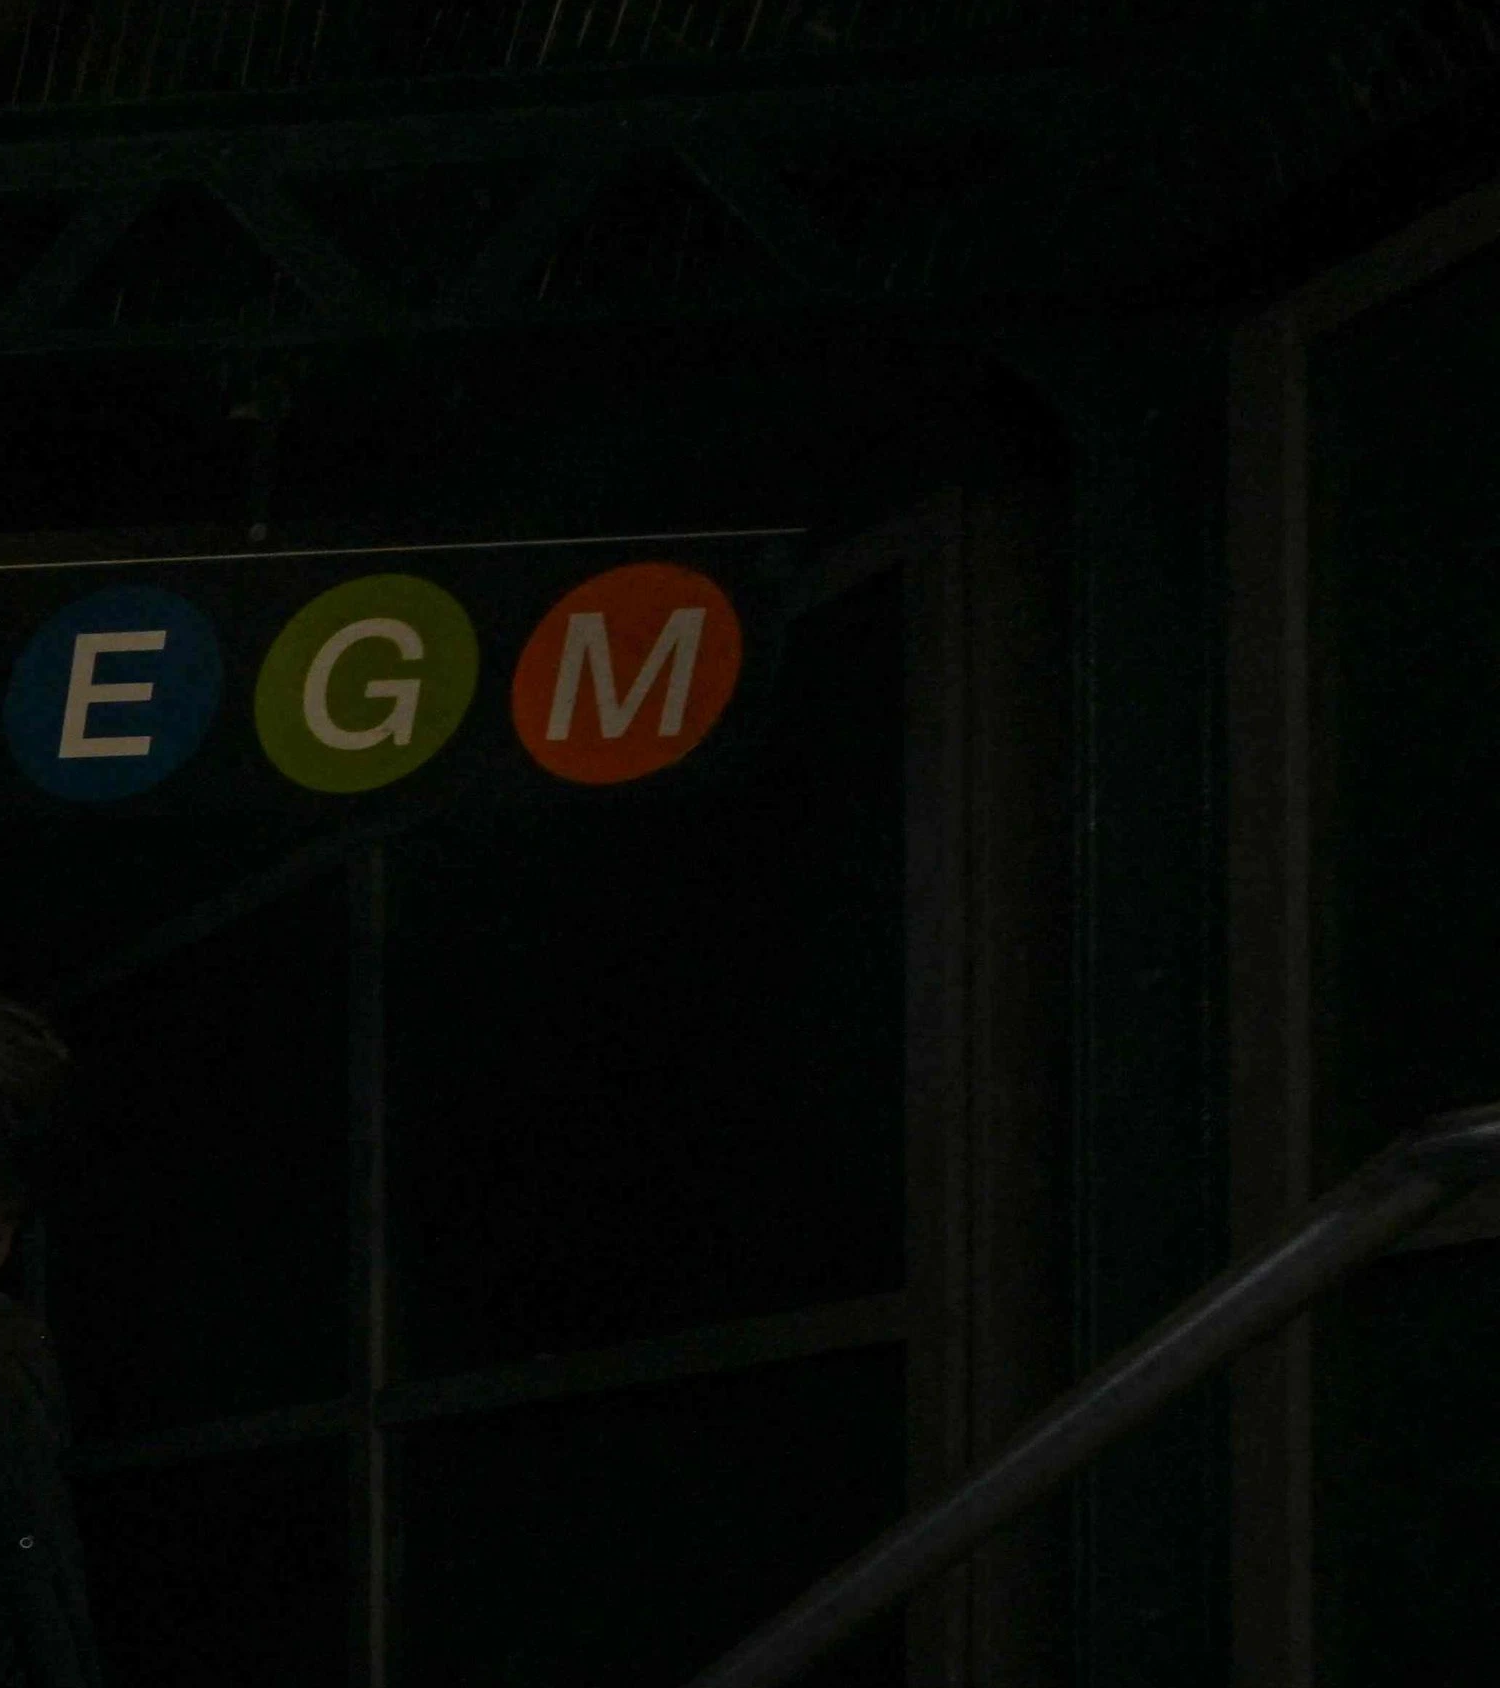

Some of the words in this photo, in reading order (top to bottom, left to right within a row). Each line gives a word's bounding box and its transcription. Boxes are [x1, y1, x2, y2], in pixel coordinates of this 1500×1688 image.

[57, 629, 168, 760] E
[303, 615, 423, 754] G
[543, 606, 710, 743] M
